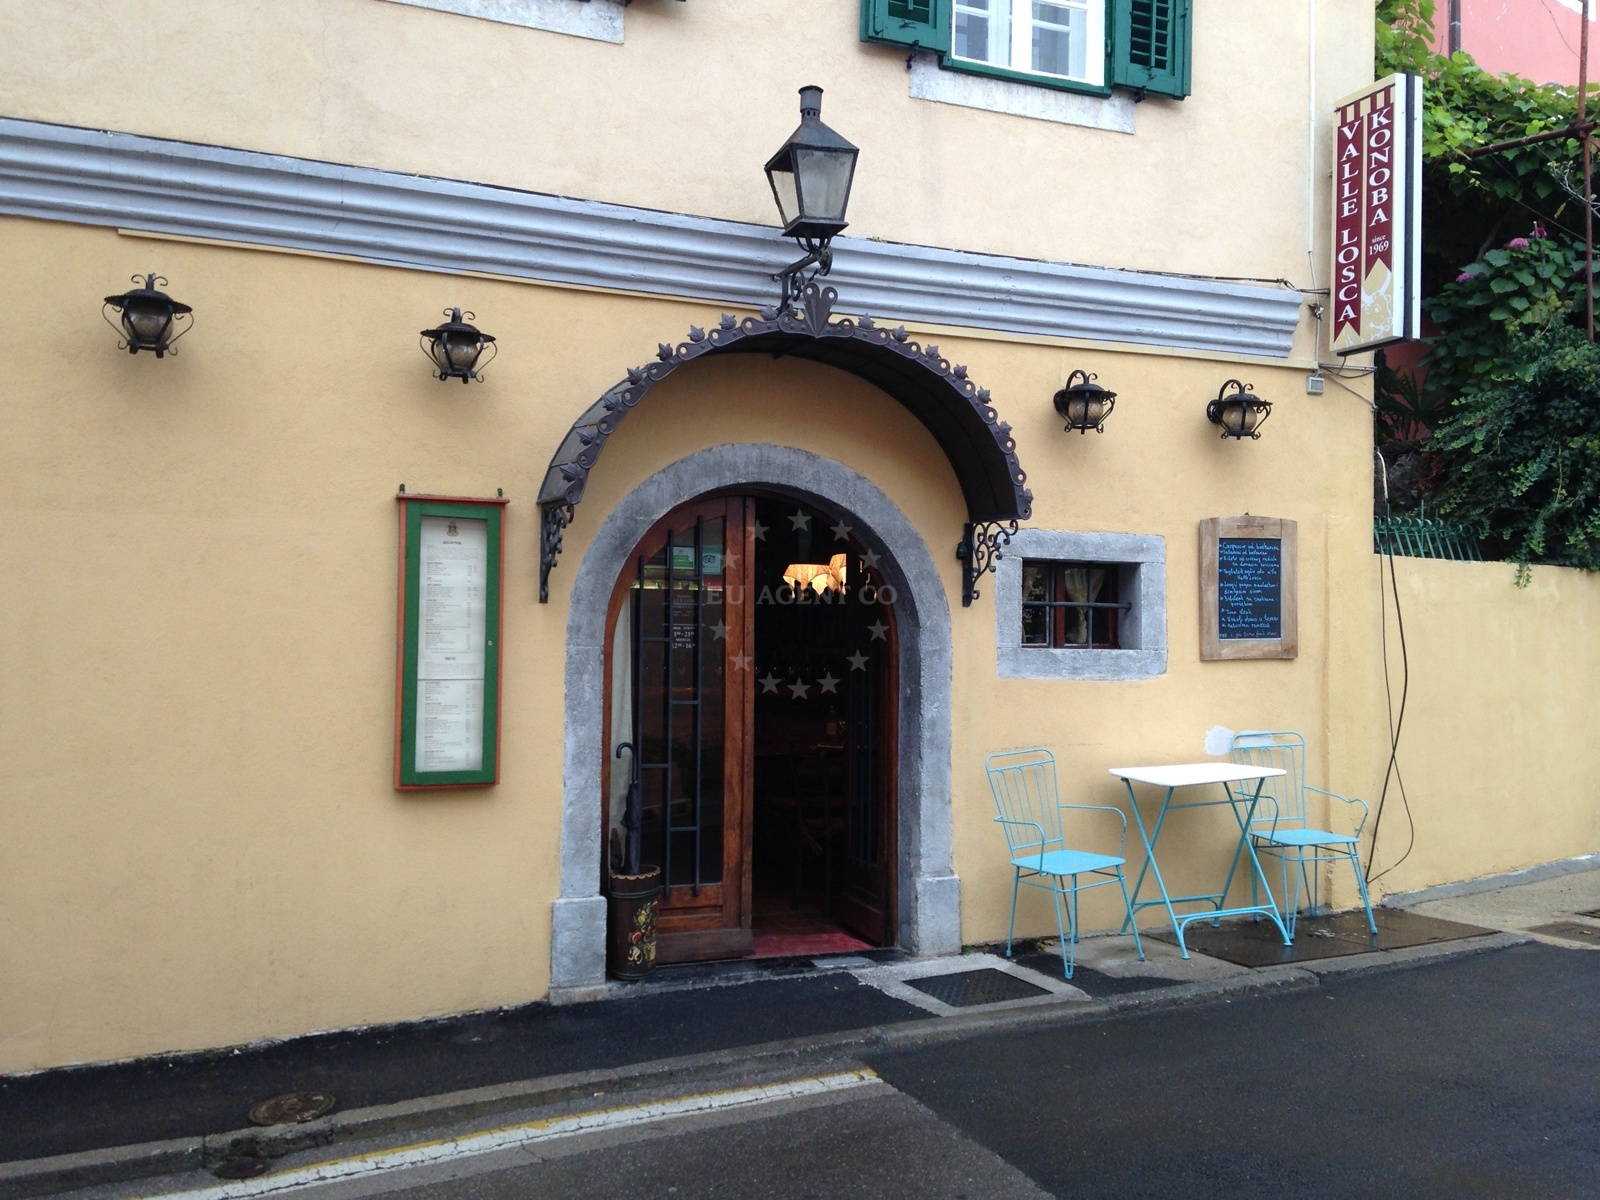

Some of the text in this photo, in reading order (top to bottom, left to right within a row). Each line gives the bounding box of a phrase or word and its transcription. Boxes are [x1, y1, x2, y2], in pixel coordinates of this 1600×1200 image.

[1368, 106, 1392, 228] KONOBA
[1337, 119, 1361, 322] VALLE LOSCA
[1368, 240, 1390, 256] 1969
[1371, 234, 1387, 244] since
